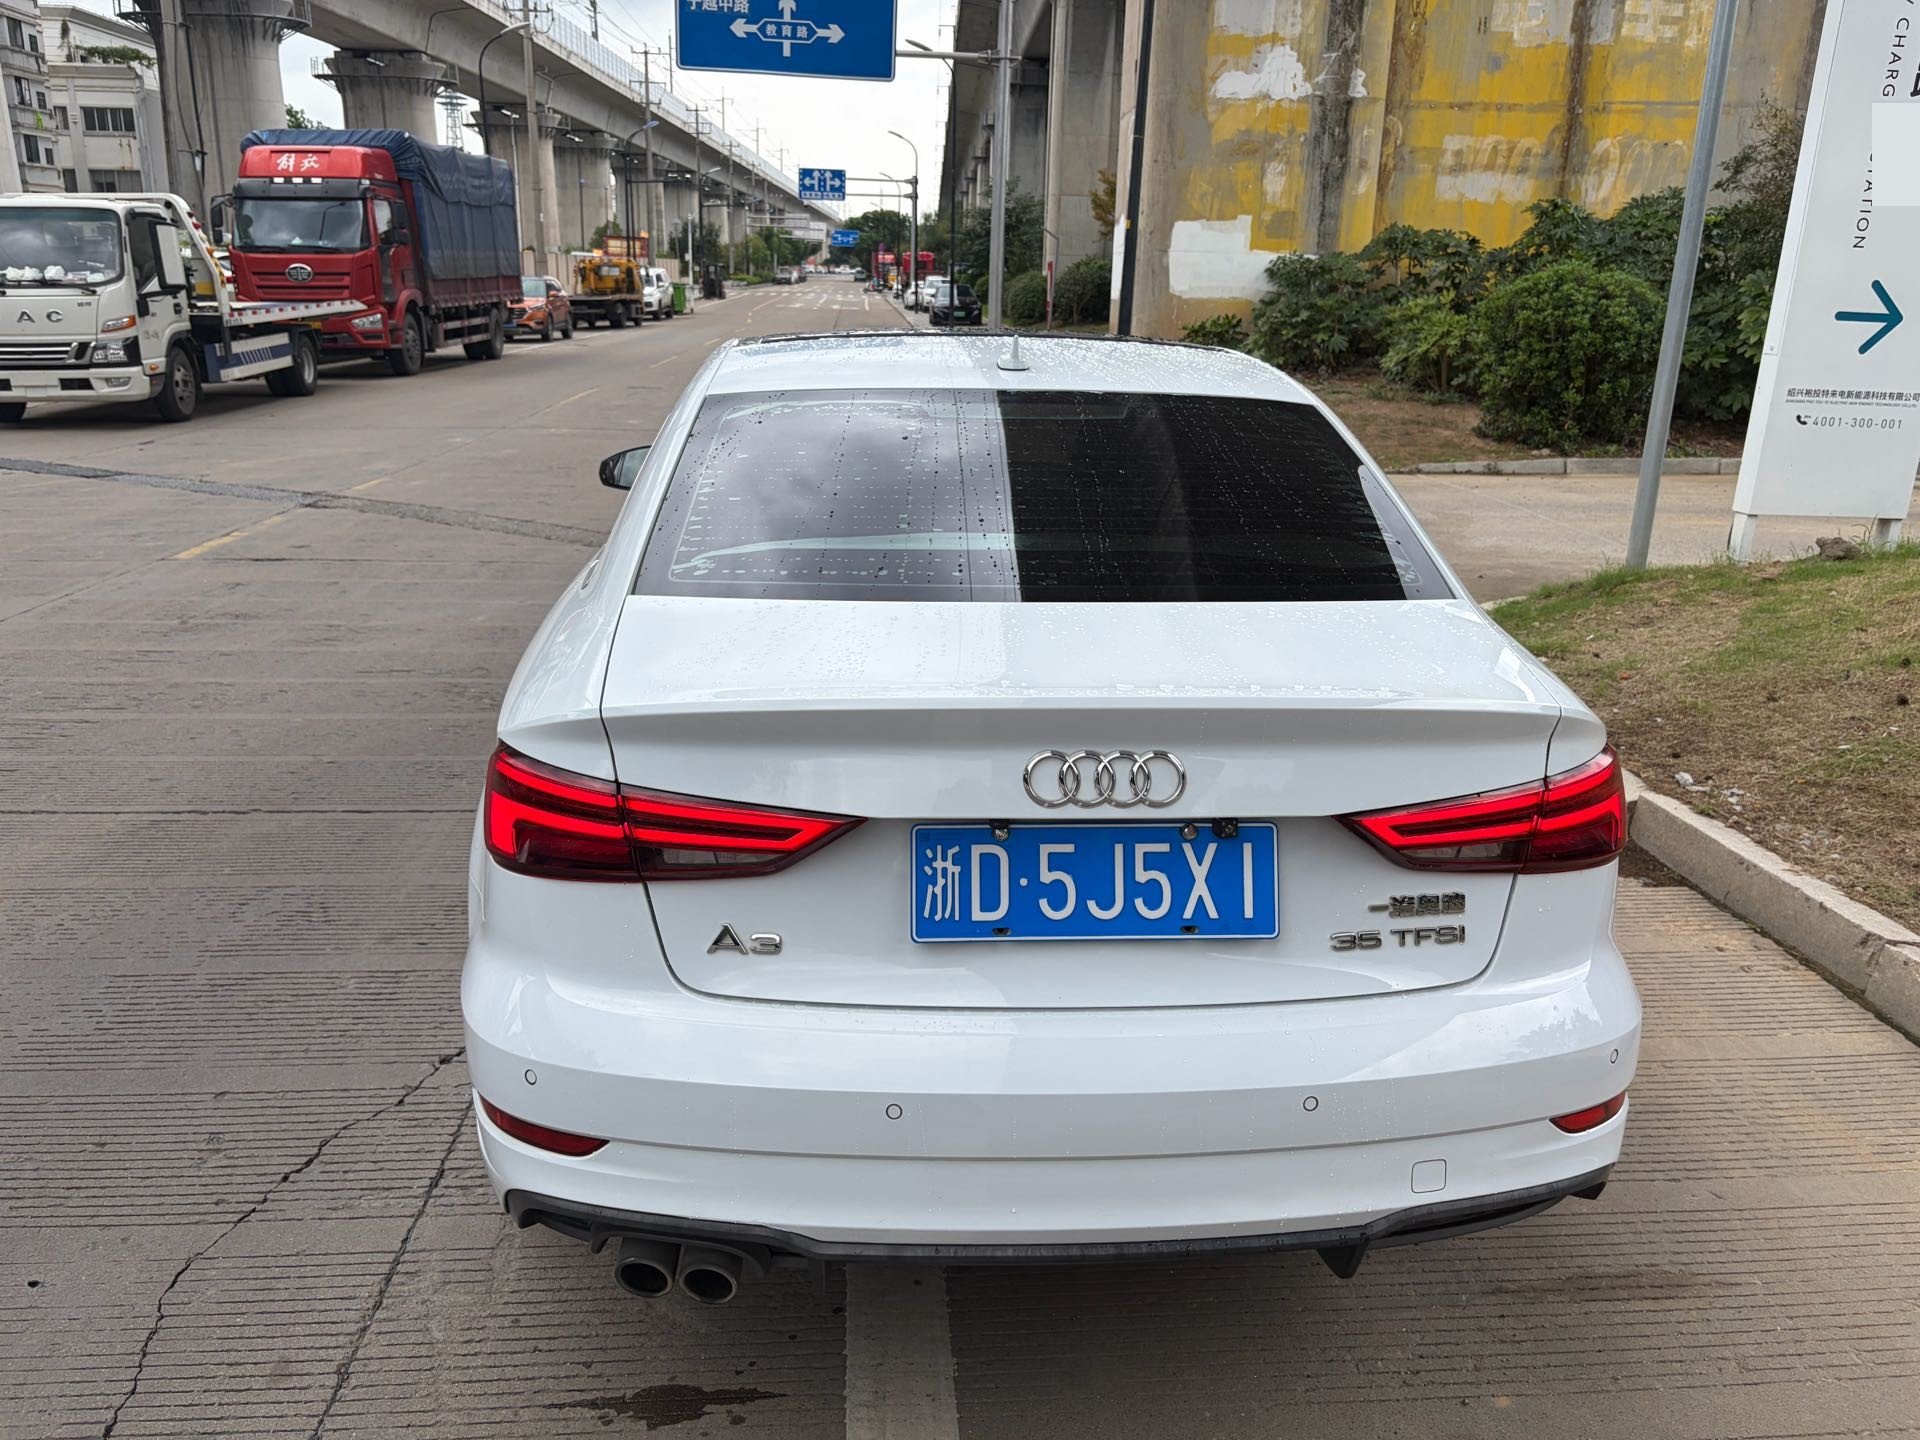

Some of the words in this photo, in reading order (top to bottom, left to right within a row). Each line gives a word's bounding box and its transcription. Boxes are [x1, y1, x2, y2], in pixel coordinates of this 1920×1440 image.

[765, 24, 809, 38] 教育路
[1882, 17, 1910, 97] CHARG
[1812, 416, 1902, 429] 4001-300-001
[706, 923, 782, 955] A3
[1330, 930, 1382, 952] 35
[1390, 924, 1466, 947] TFSI
